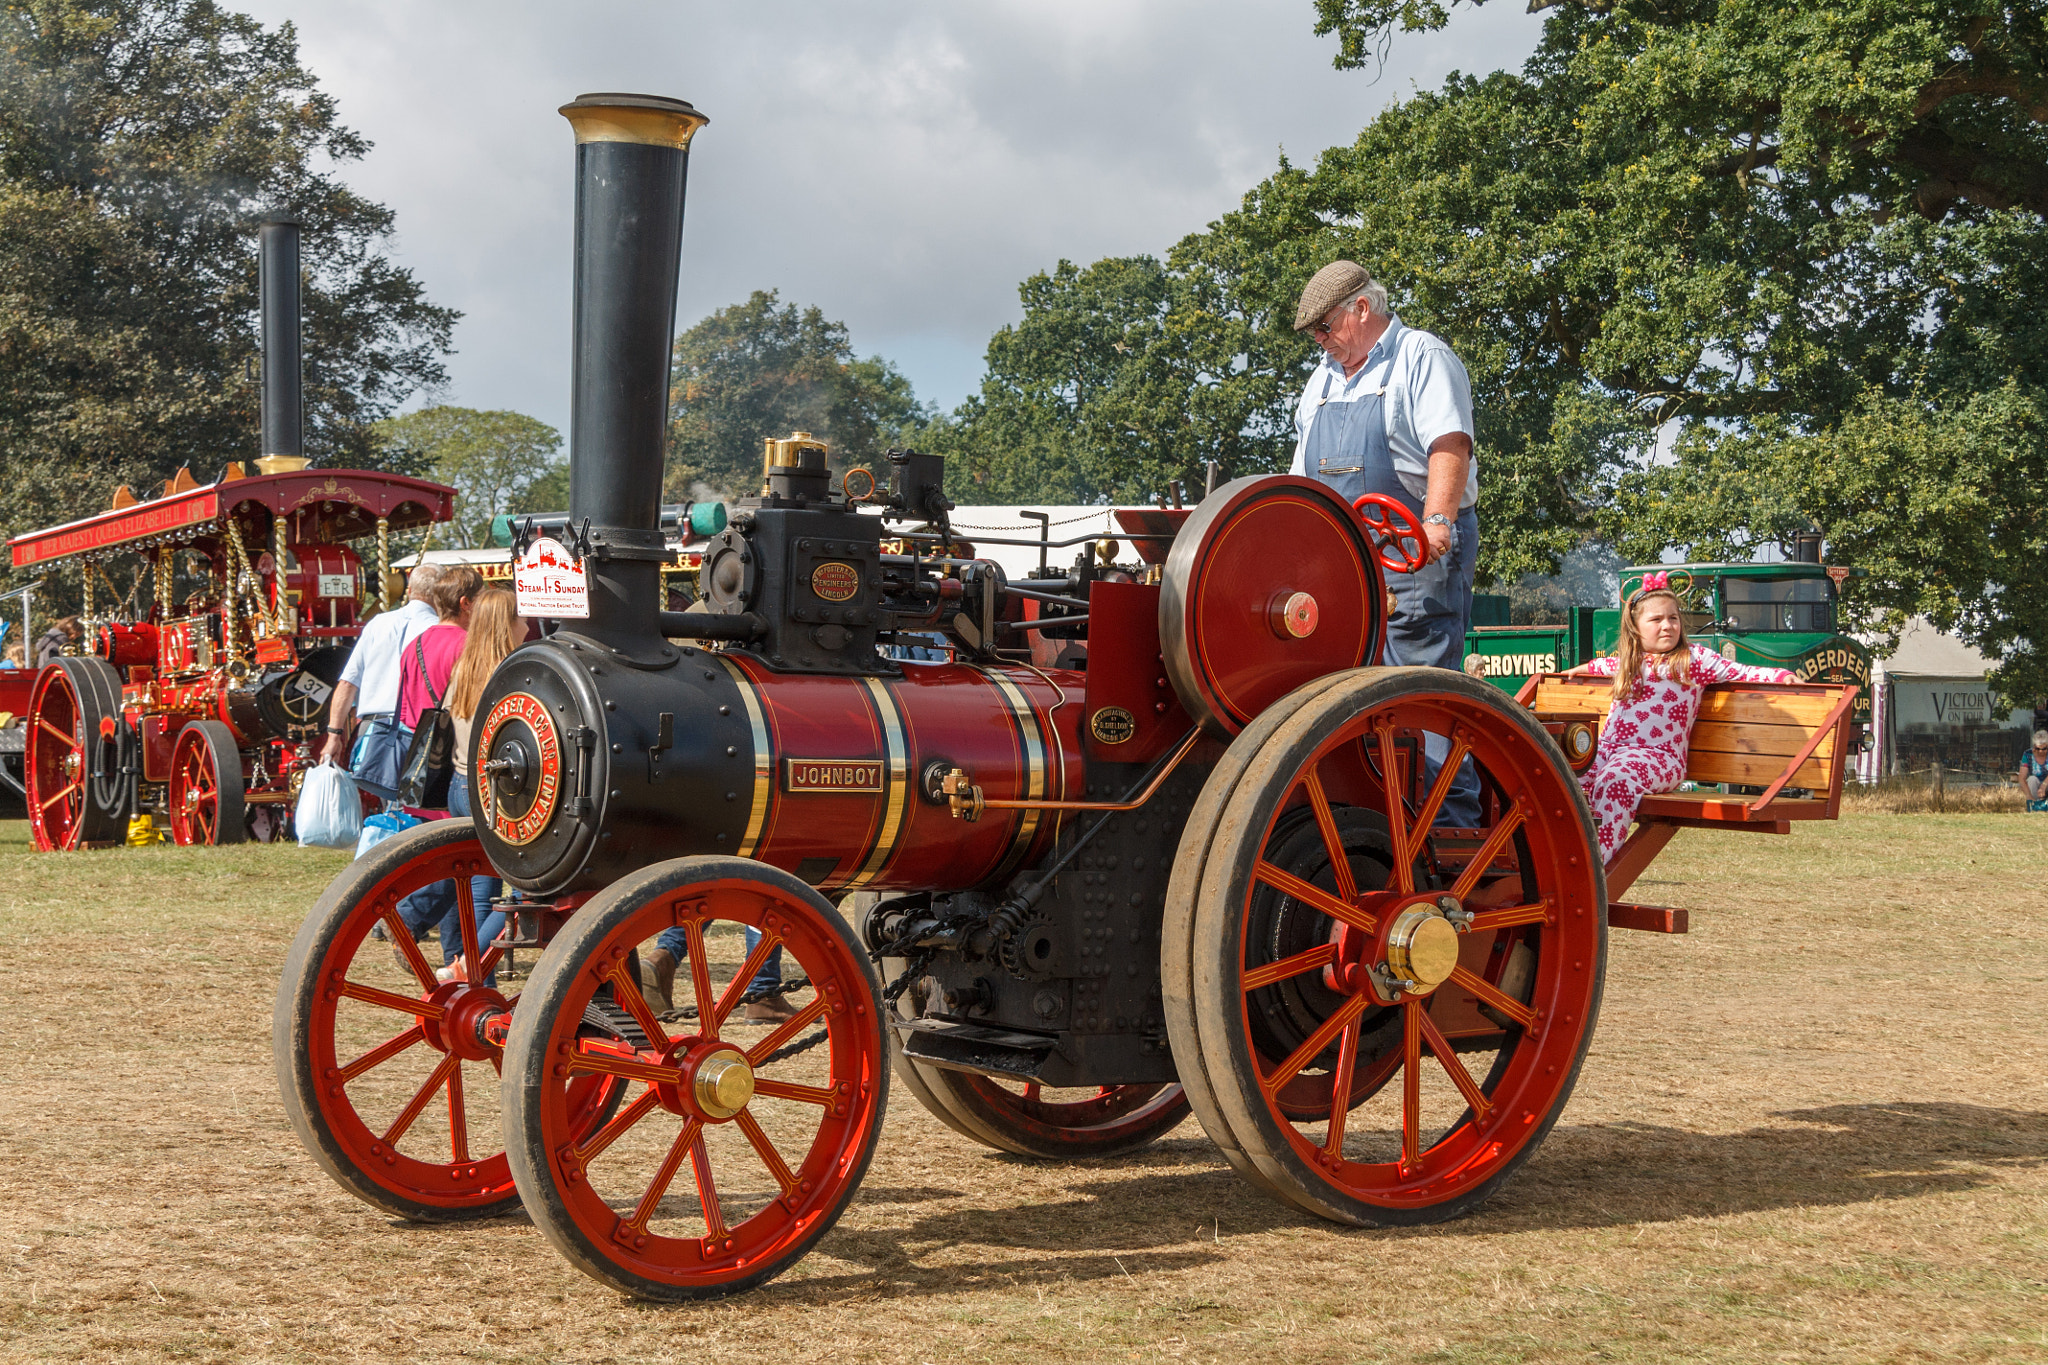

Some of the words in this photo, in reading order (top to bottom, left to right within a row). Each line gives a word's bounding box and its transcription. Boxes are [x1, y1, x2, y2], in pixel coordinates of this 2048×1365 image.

[60, 529, 93, 551] MAJESTY
[96, 521, 123, 544] QUEEN
[125, 506, 171, 534] ELIZABETH
[823, 565, 845, 574] FOSTER
[554, 580, 585, 594] SUNDAY
[819, 579, 852, 588] ENGINEERS
[821, 588, 849, 598] LINCOLN
[1483, 653, 1556, 678] GROYNES
[1795, 648, 1871, 689] ABERDEEN
[303, 678, 324, 695] 37
[1830, 674, 1844, 683] SEA
[1931, 692, 1998, 722] VICTORY
[487, 697, 525, 735] FOSTER
[525, 703, 535, 720] &
[1948, 711, 1960, 721] ON
[1963, 711, 1985, 721] TOUR
[796, 766, 877, 785] JOHNBOY
